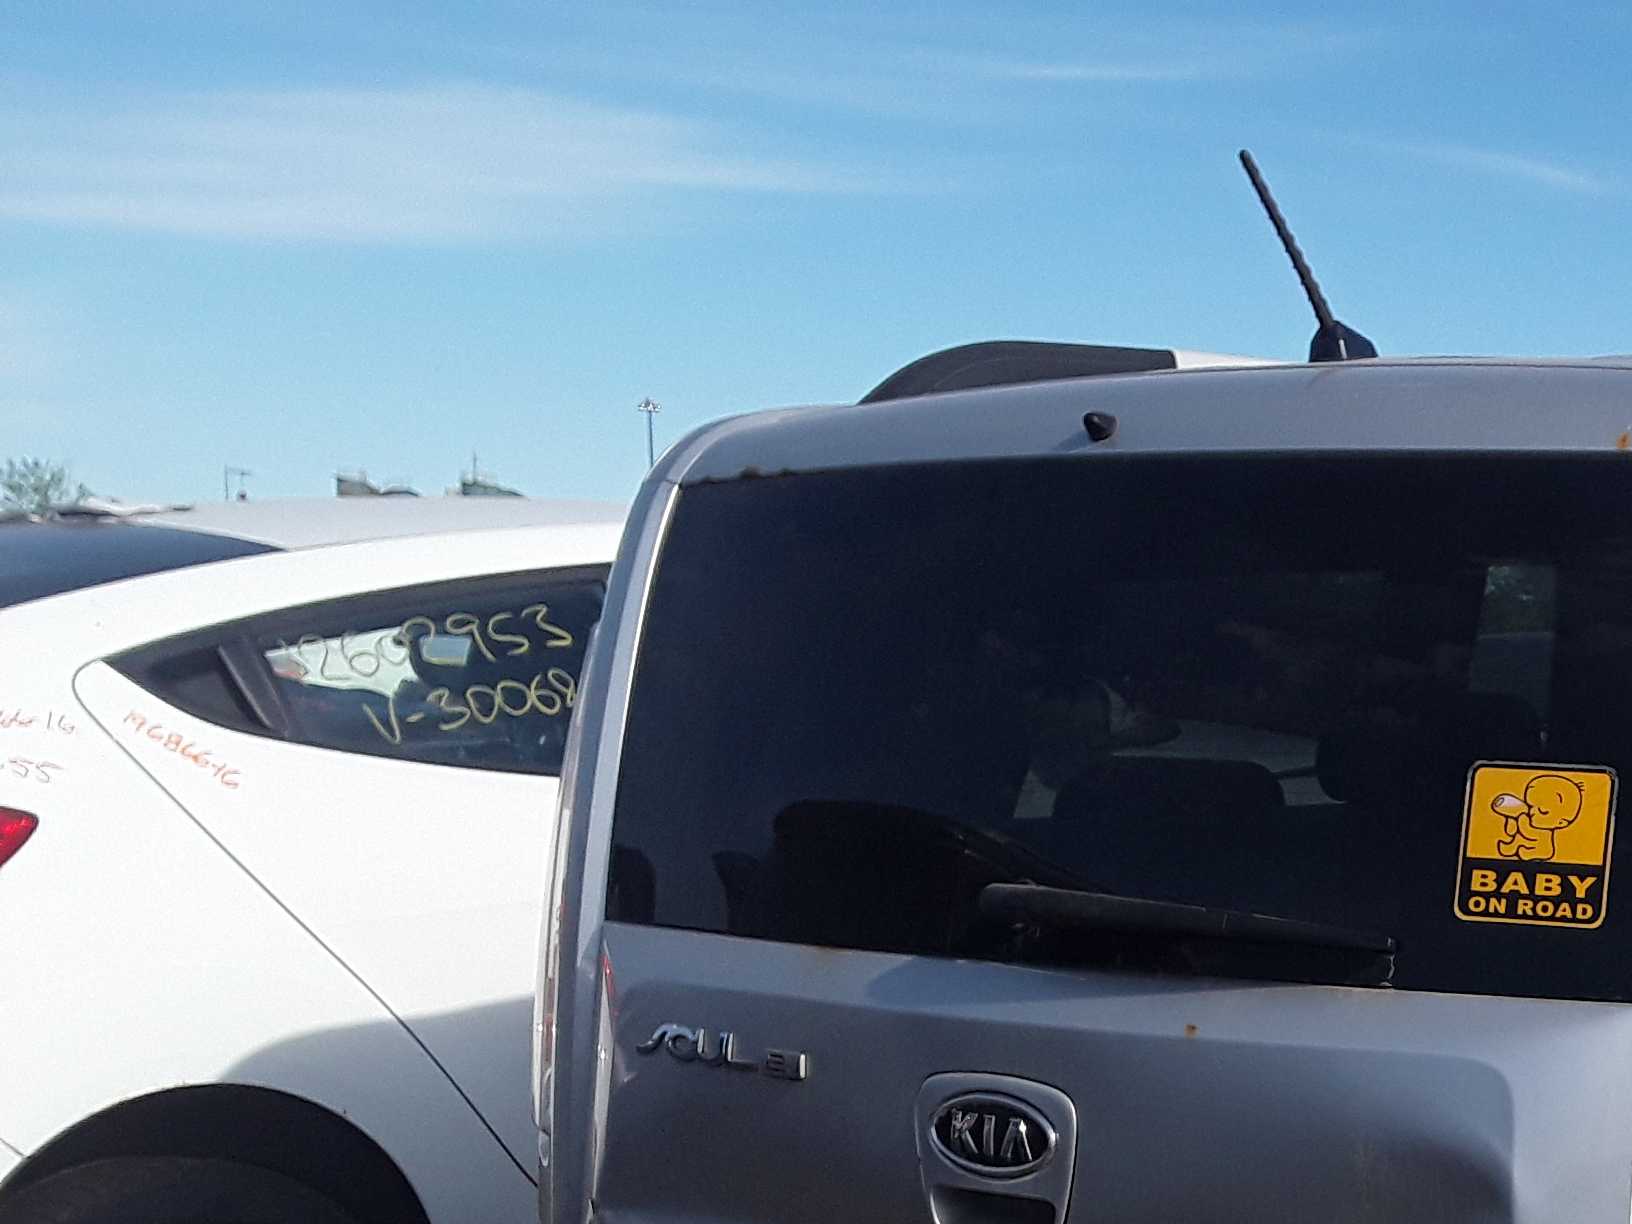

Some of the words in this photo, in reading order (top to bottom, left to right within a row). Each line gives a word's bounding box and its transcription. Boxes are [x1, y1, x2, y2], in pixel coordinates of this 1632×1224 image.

[1470, 869, 1598, 898] BABY
[1467, 895, 1507, 915] ON
[1516, 898, 1594, 920] ROAD
[636, 1023, 760, 1073] SOUL
[950, 1107, 1033, 1161] KIA
